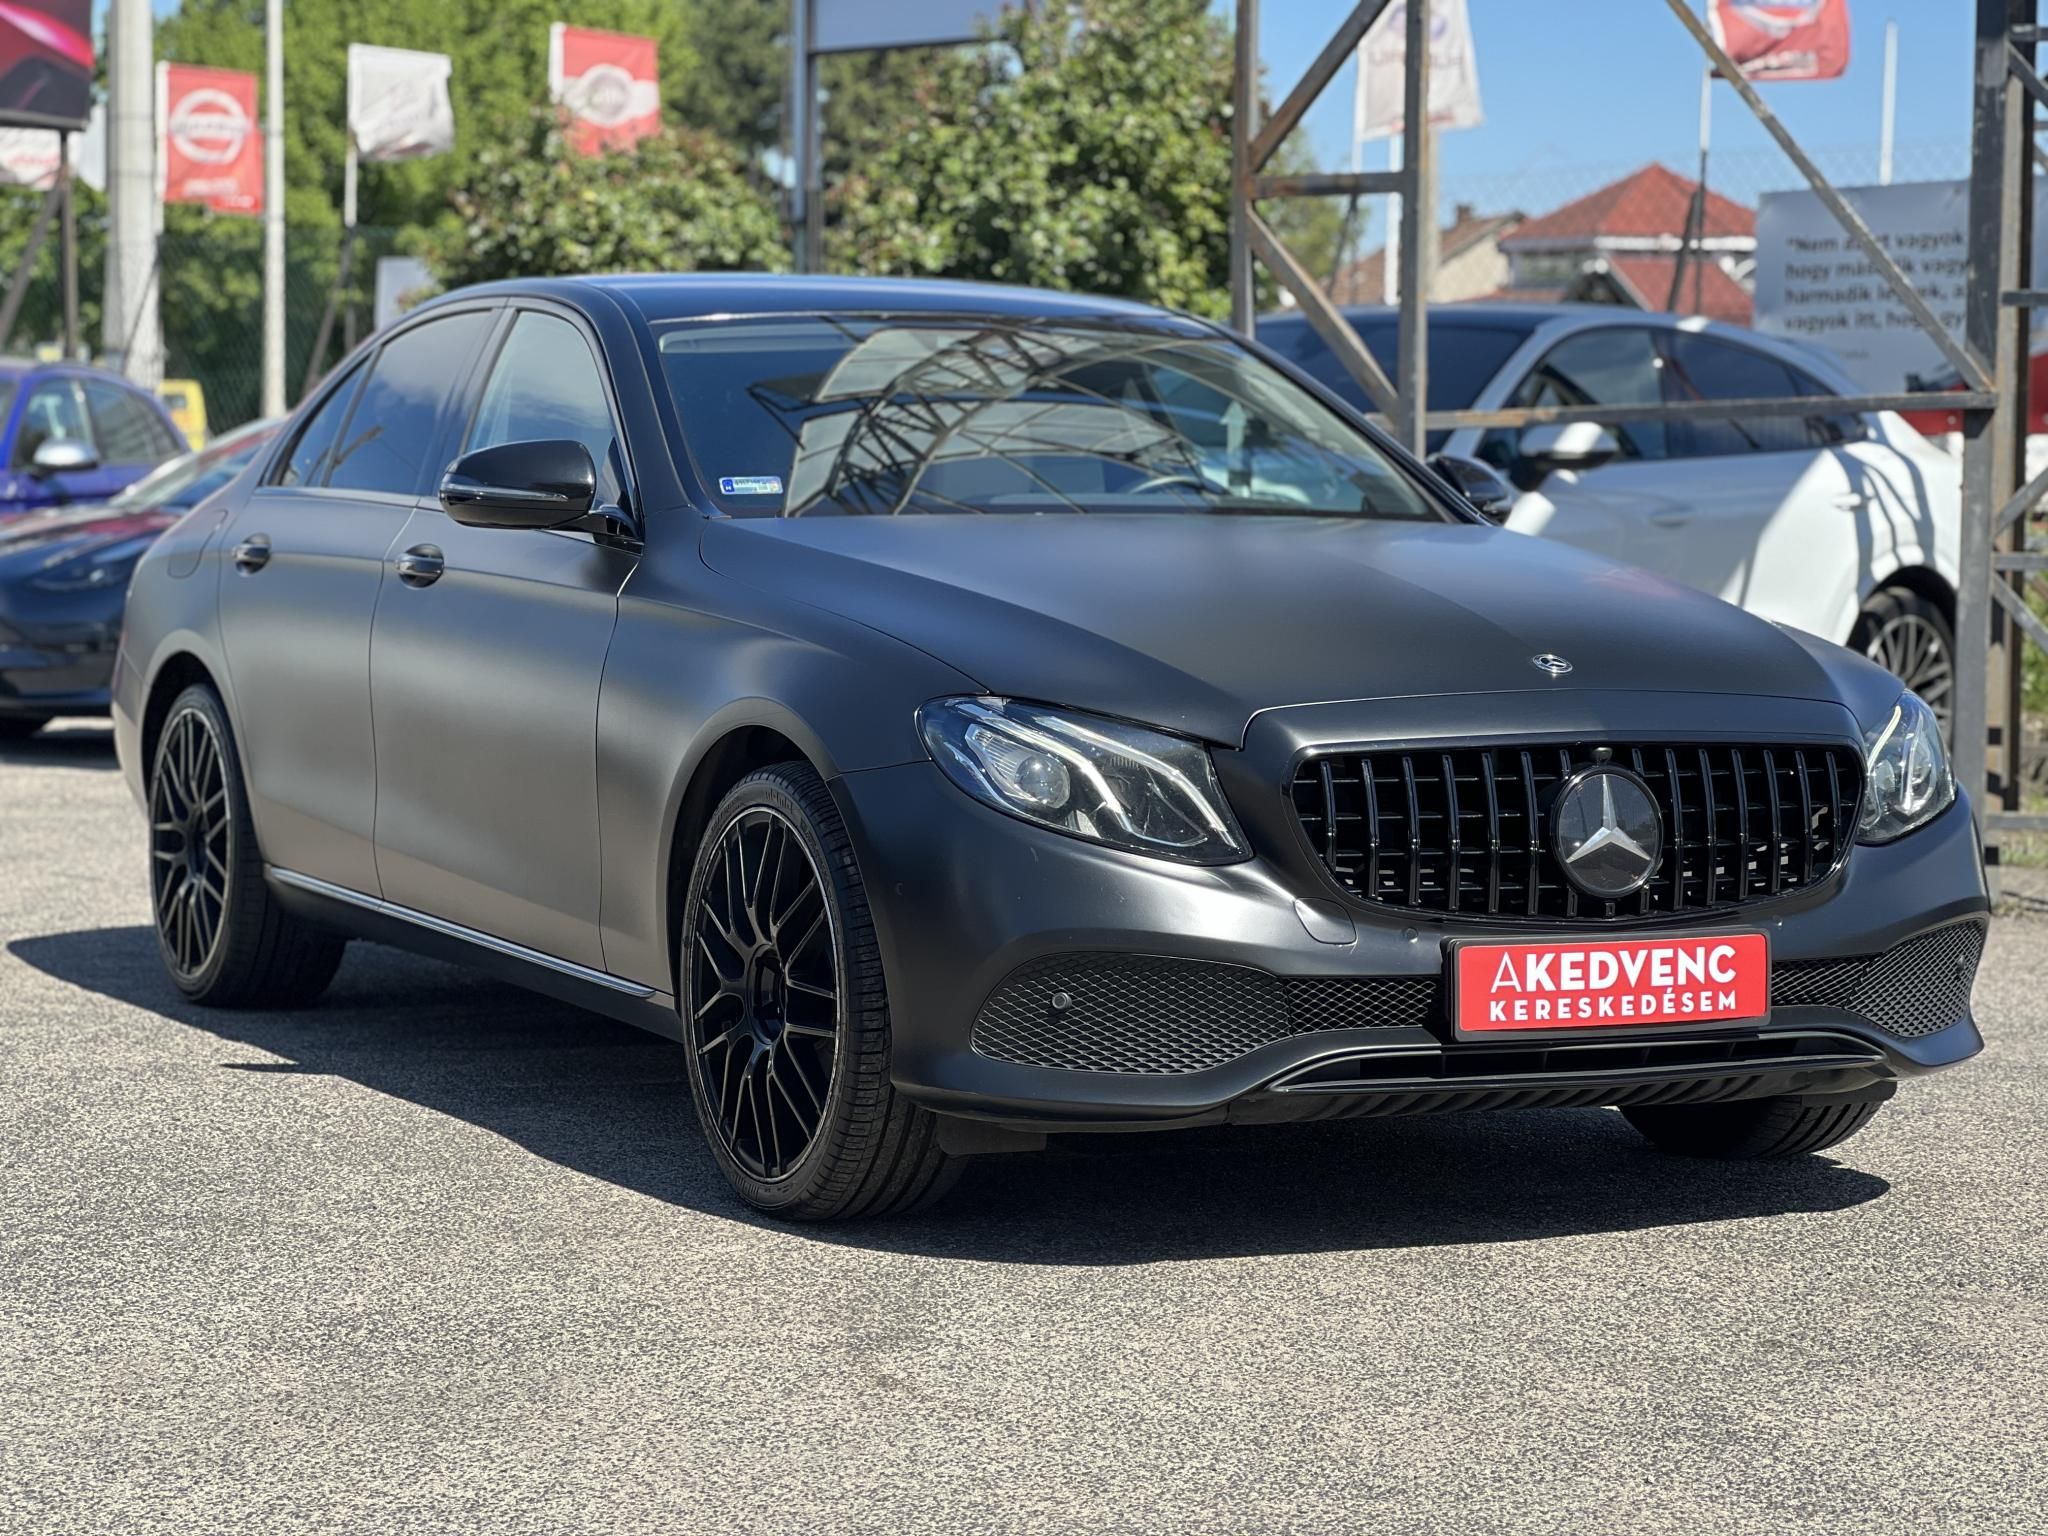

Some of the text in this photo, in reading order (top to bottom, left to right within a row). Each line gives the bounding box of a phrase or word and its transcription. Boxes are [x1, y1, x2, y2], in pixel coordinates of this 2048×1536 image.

[1785, 262, 1830, 281] hogy
[1785, 312, 1848, 332] vagyok
[1489, 988, 1737, 1022] KERESKEDÉSEM
